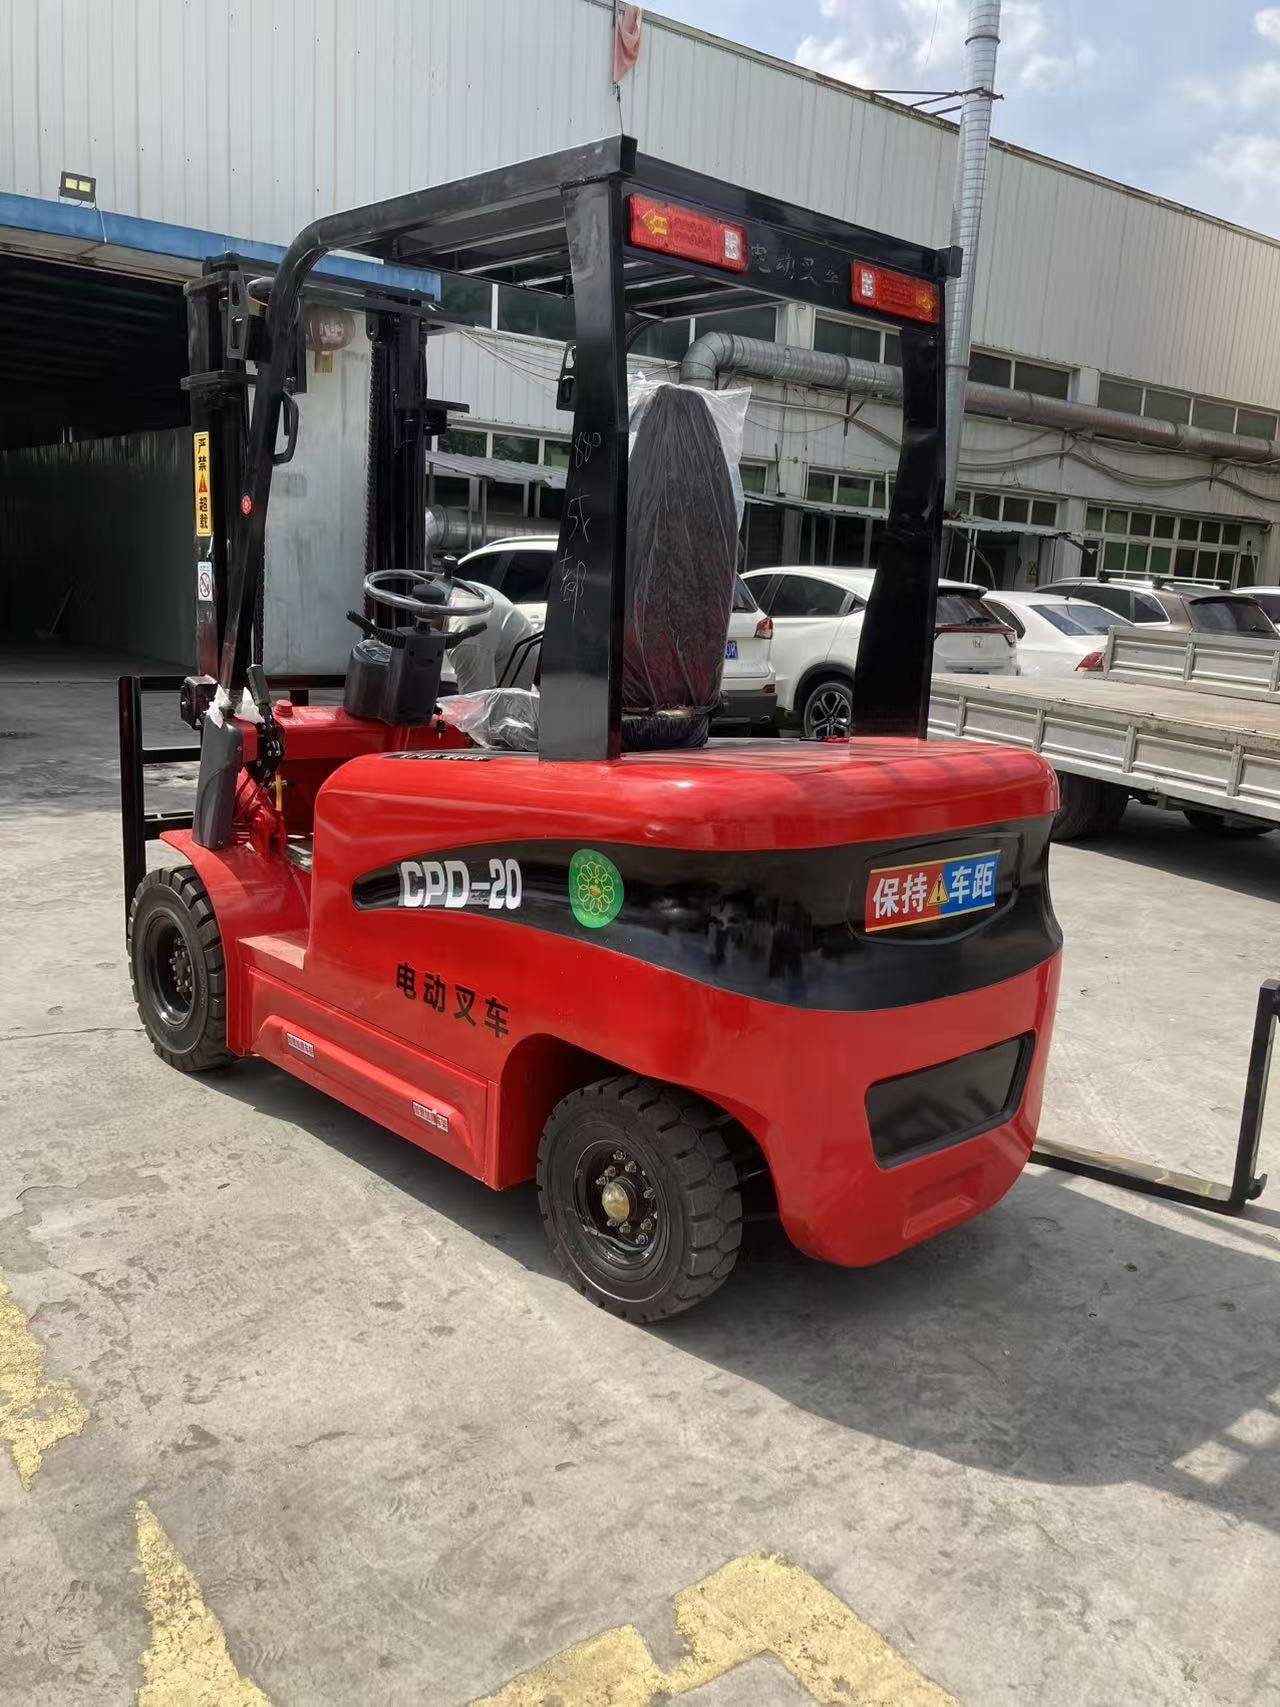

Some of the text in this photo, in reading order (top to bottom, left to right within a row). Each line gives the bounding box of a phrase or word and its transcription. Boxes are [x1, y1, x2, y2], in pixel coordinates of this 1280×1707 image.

[400, 858, 523, 910] CPD-20
[873, 861, 995, 919] 保持 车距
[396, 961, 509, 1038] 电动叉车
